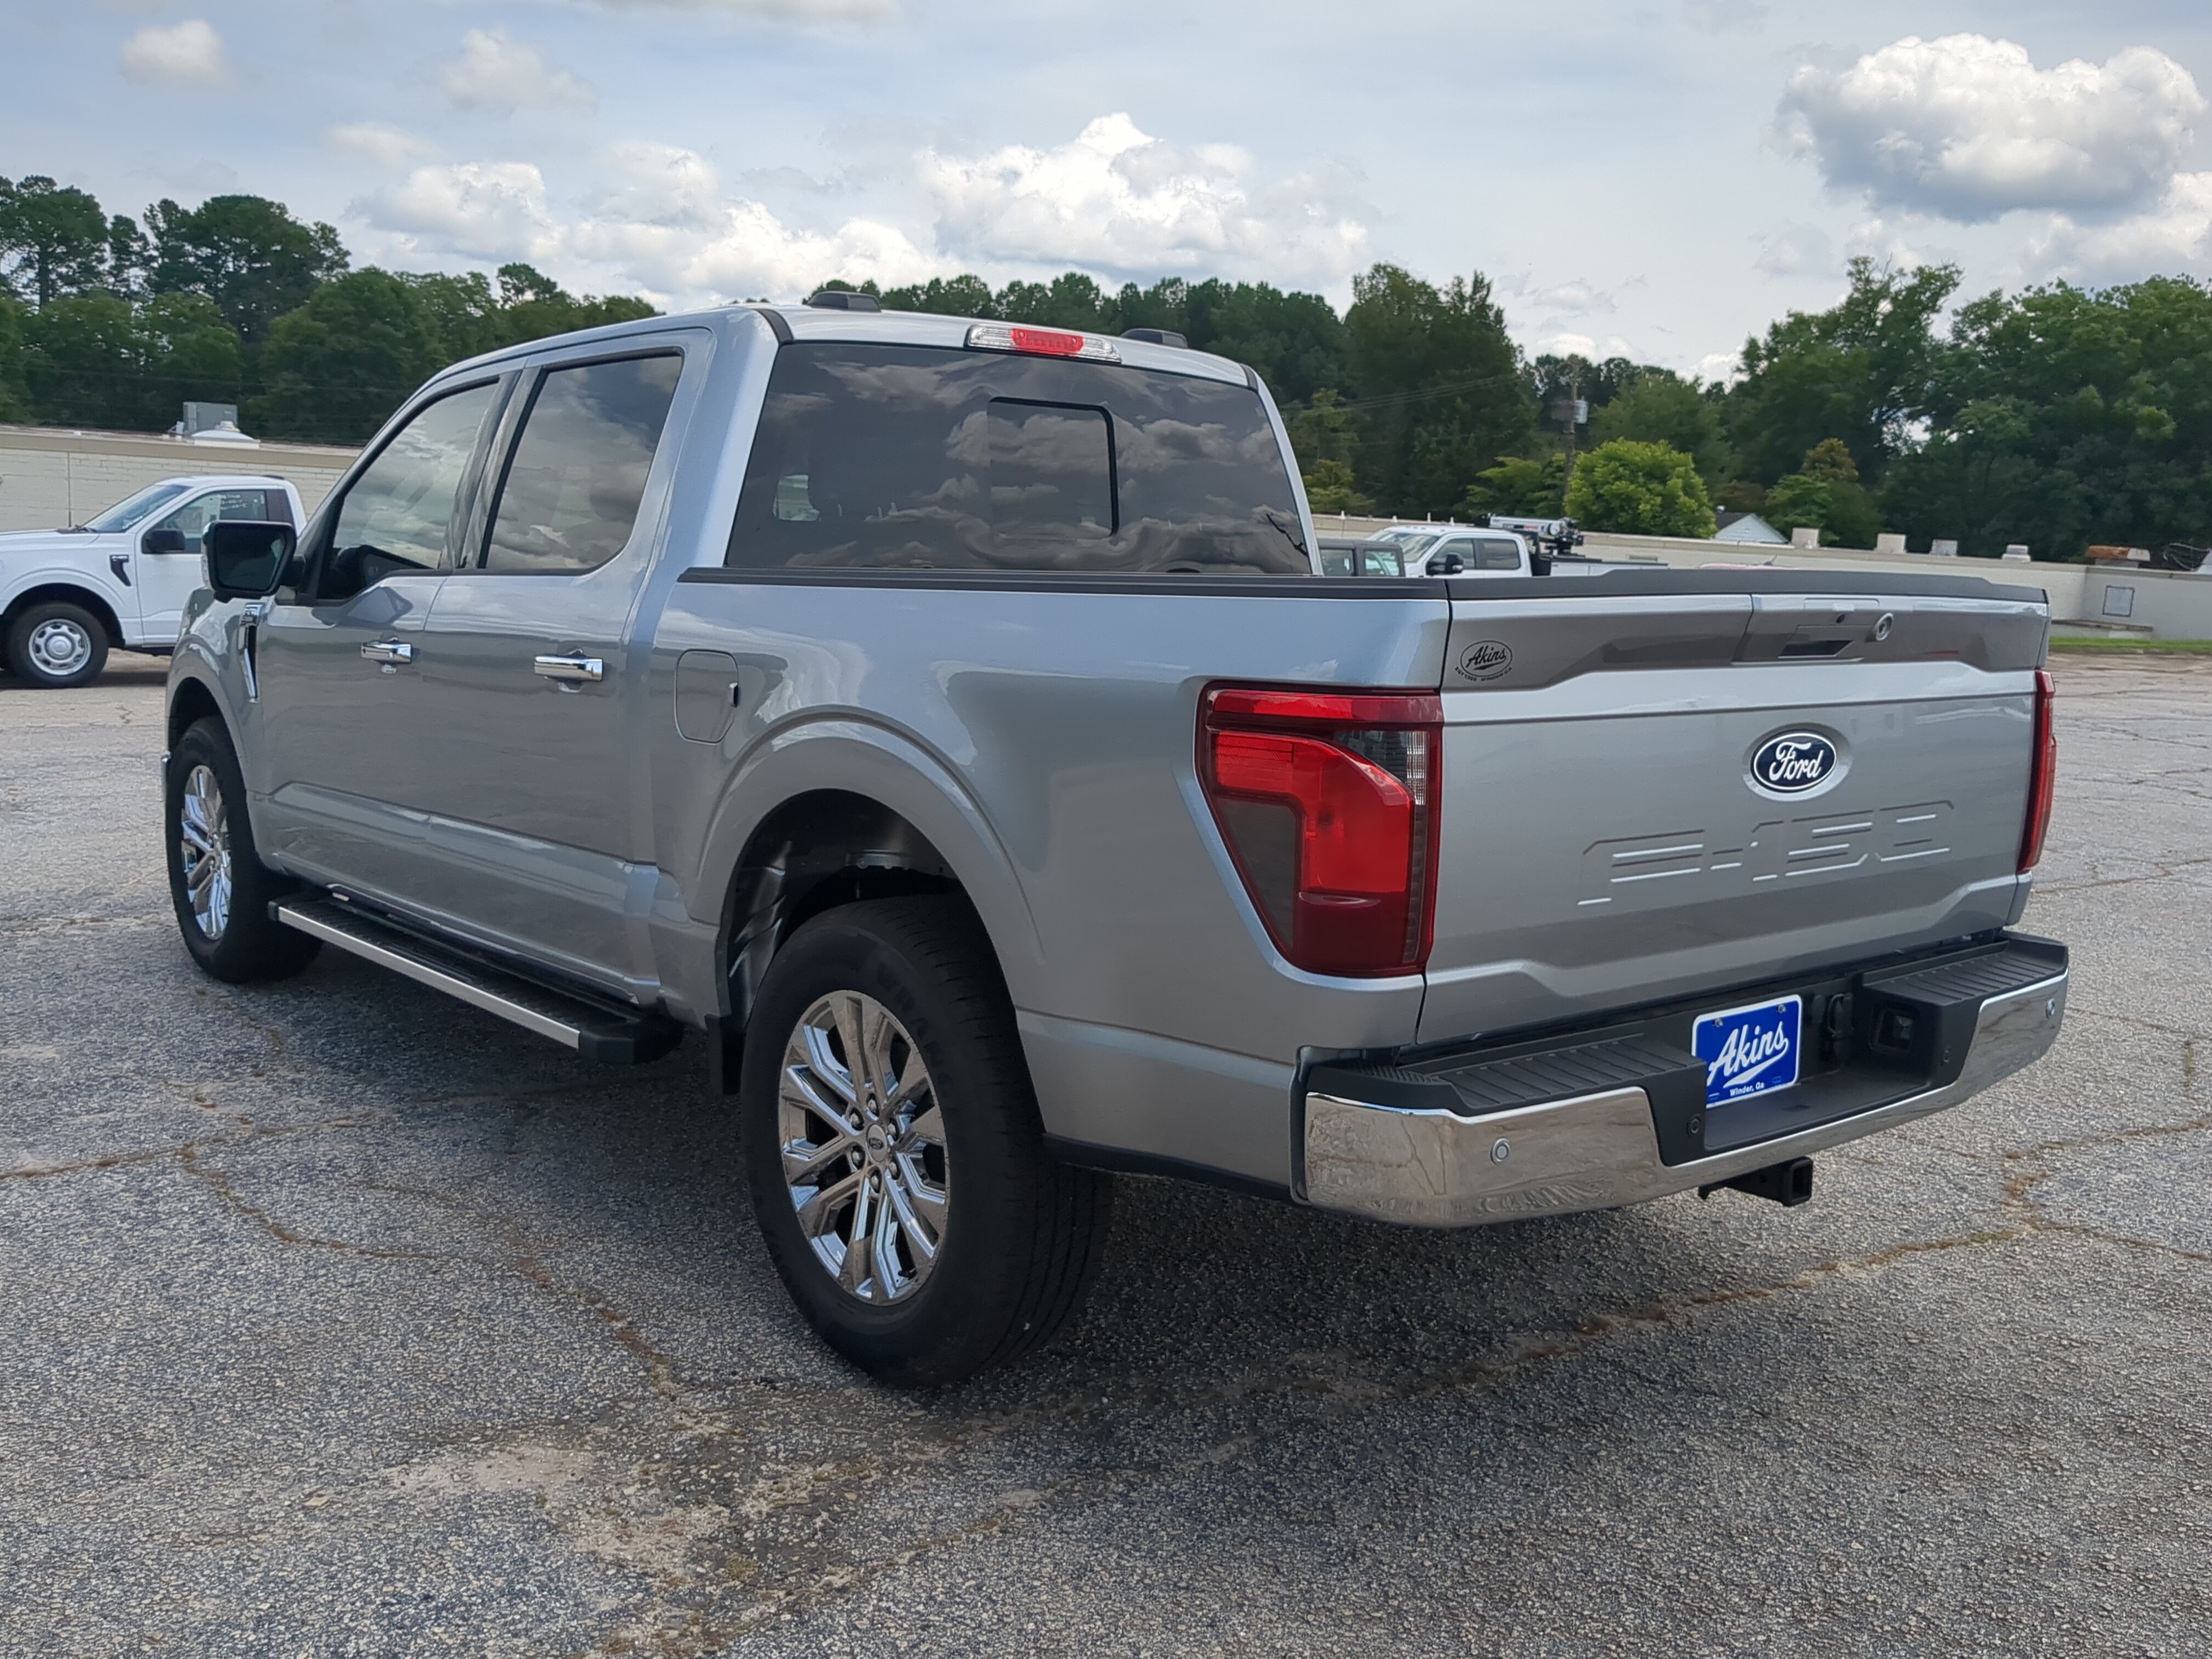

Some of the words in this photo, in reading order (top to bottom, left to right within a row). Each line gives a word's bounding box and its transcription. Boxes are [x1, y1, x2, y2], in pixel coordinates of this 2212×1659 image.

[1466, 645, 1506, 668] Akins
[1769, 742, 1824, 781] Ford
[1577, 800, 1954, 905] F-150
[1707, 1021, 1788, 1087] Akins
